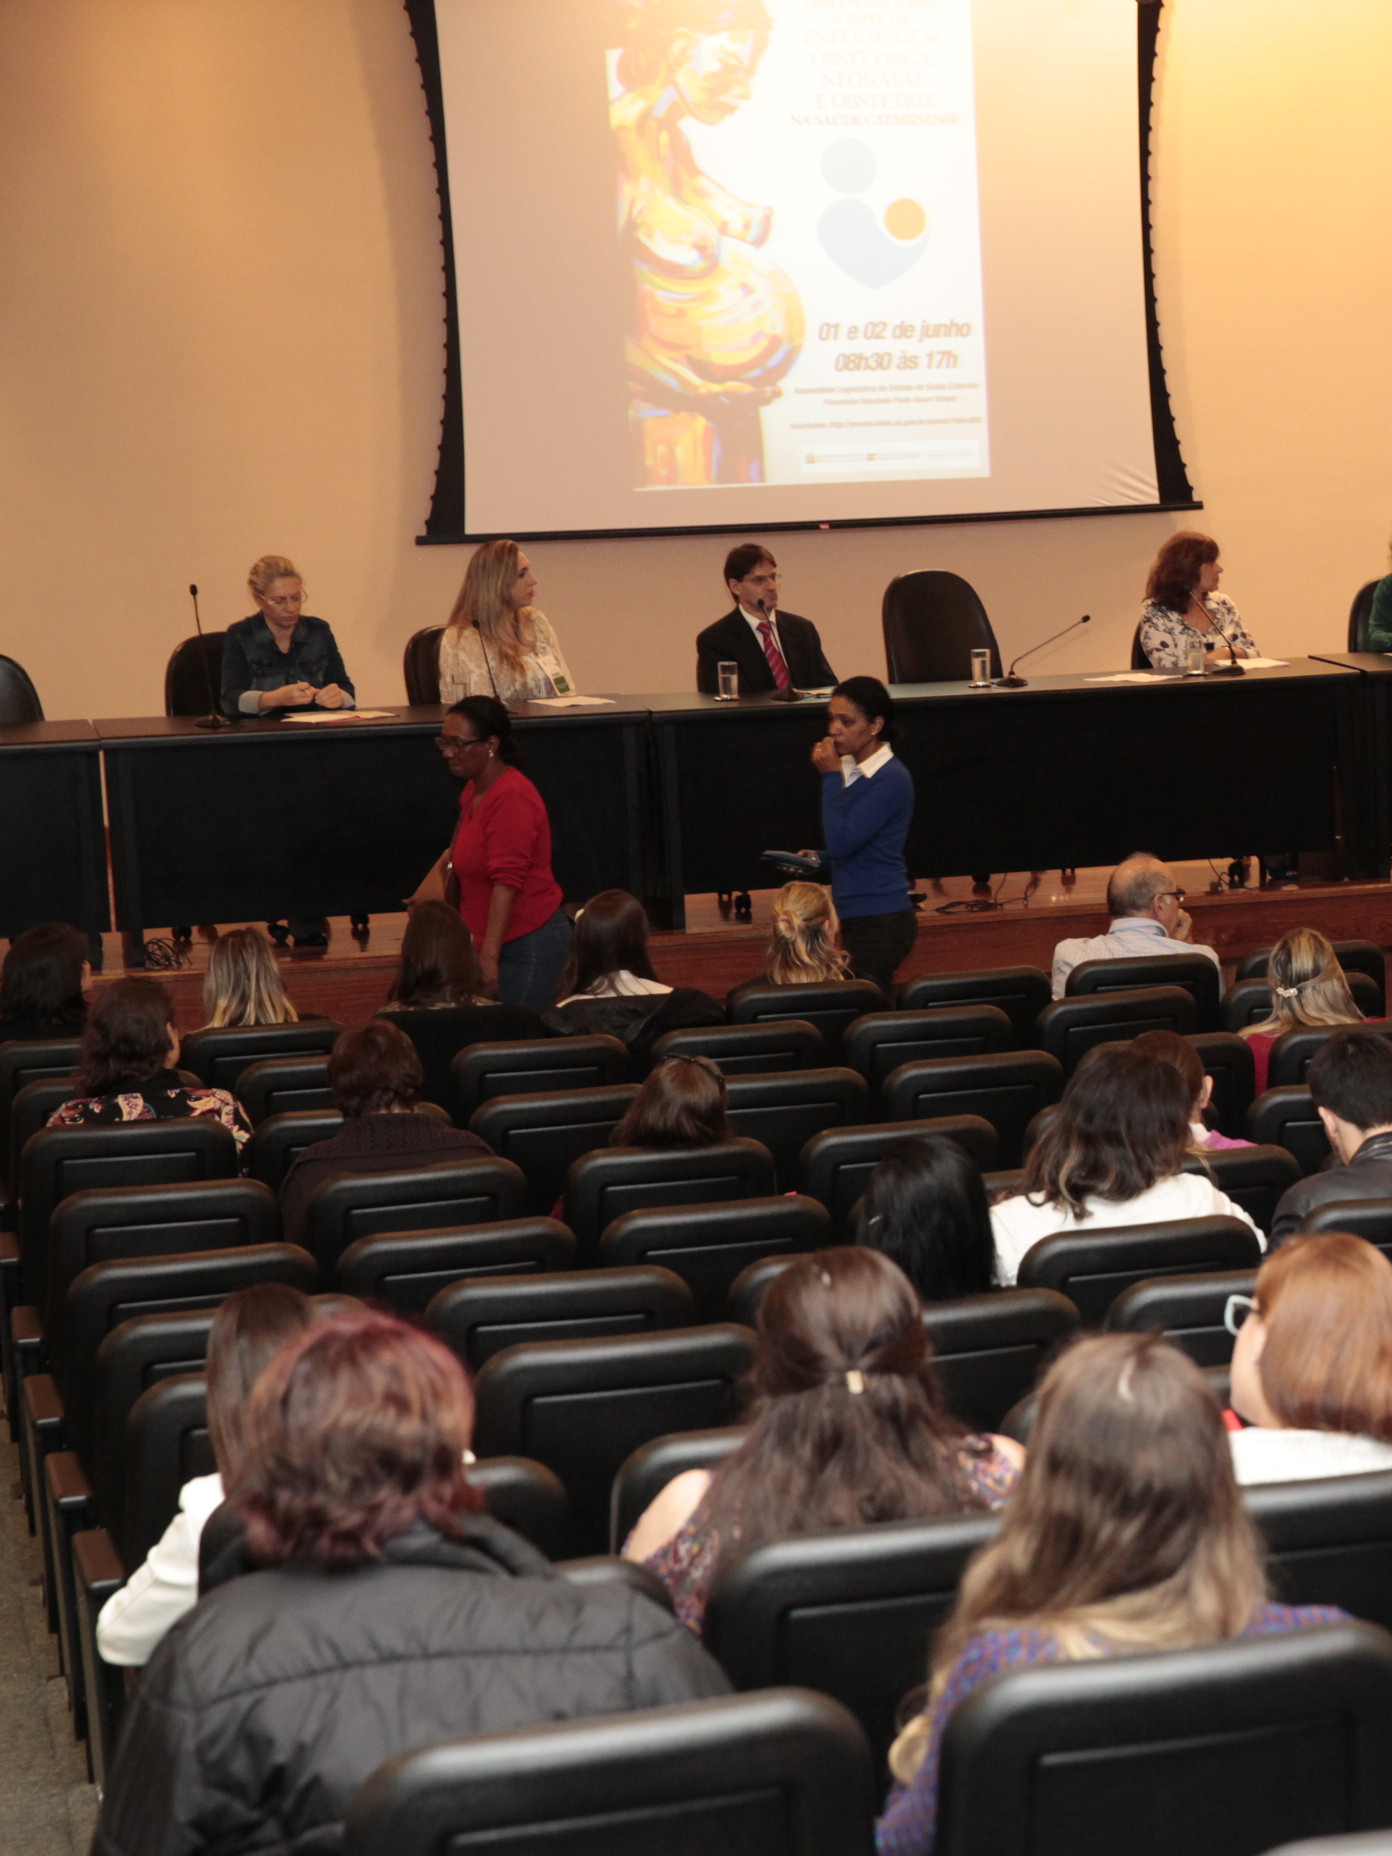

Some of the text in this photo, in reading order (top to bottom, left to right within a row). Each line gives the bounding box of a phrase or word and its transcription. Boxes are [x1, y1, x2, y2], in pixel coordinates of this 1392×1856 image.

[790, 114, 811, 127] NA
[818, 319, 972, 343] 01 e 02 de junho
[835, 350, 959, 372] 08h30 às 17h
